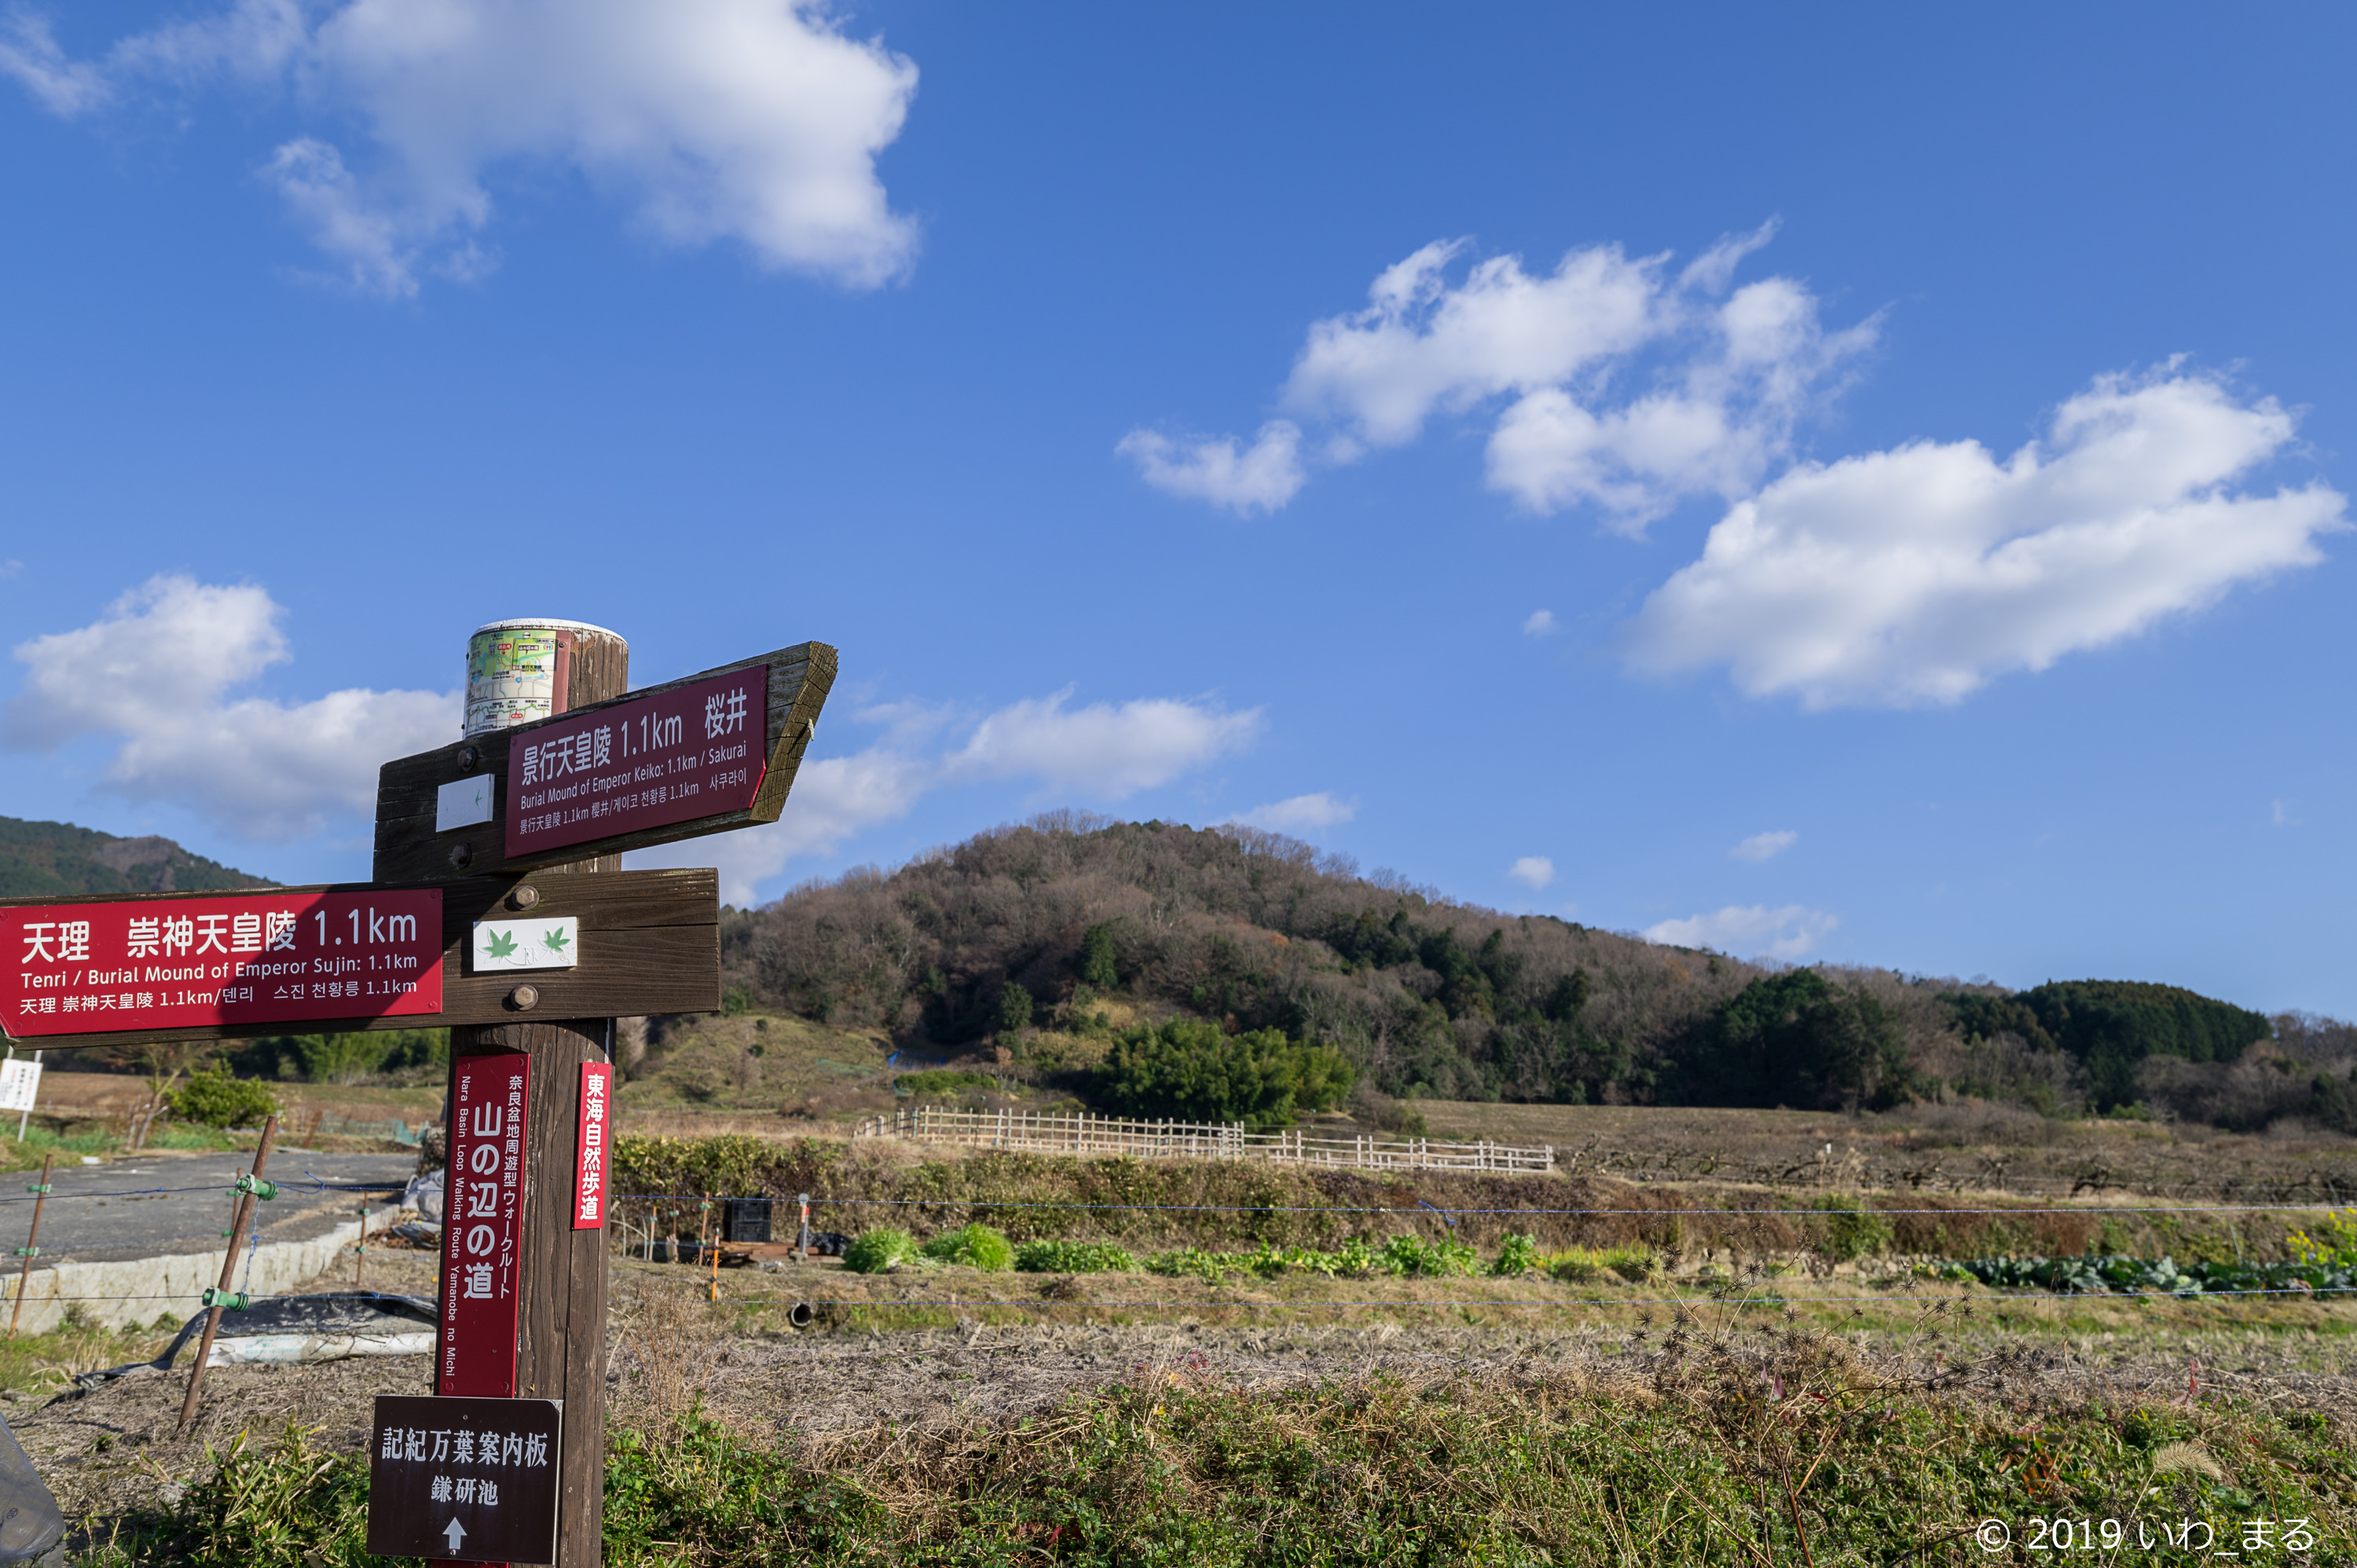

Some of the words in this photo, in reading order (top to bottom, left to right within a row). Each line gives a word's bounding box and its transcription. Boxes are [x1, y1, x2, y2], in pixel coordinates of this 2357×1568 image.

[522, 724, 611, 786] 景行天皇陵
[621, 712, 682, 757] 1.1km
[705, 687, 747, 739] 桜井
[521, 789, 545, 810] Burial
[548, 782, 577, 804] Mound
[580, 779, 590, 795] of
[592, 771, 632, 793] Emperor
[634, 763, 664, 782] Keiko:
[668, 755, 697, 774] 1.1km
[709, 740, 746, 764] Sakurai
[519, 811, 561, 835] 景行天皇陵
[563, 807, 588, 824] 1.1km
[670, 782, 699, 800] 1.1km
[709, 768, 746, 791] 사쿠라이
[22, 920, 90, 965] 天理
[127, 910, 297, 958] 崇神天皇陵
[314, 907, 417, 947] 1.1km
[20, 970, 67, 989] Tenri
[88, 966, 139, 985] Burial
[145, 963, 204, 982] Mound
[211, 962, 229, 979] of
[235, 961, 307, 980] Emperor
[313, 958, 361, 976] Sujin:
[368, 954, 418, 970] 1.1km
[20, 997, 57, 1015] 天理
[62, 991, 154, 1013] 崇神天皇陵
[273, 983, 305, 1000] 스진
[311, 980, 361, 999] 천황릉
[366, 979, 418, 995] 1.1km
[460, 1075, 471, 1102] Nara
[458, 1108, 469, 1138] Basin
[455, 1145, 467, 1171] Loop
[580, 1073, 605, 1221] 東海自然歩道
[452, 1177, 465, 1221] Walking
[463, 1101, 502, 1300] 山の辺の道
[451, 1227, 462, 1259] Route
[448, 1265, 460, 1322] Yamanobe
[447, 1328, 456, 1342] no
[445, 1346, 456, 1376] Michi
[381, 1426, 548, 1468] 記紀万葉案内板
[431, 1475, 499, 1507] 鎌研池
